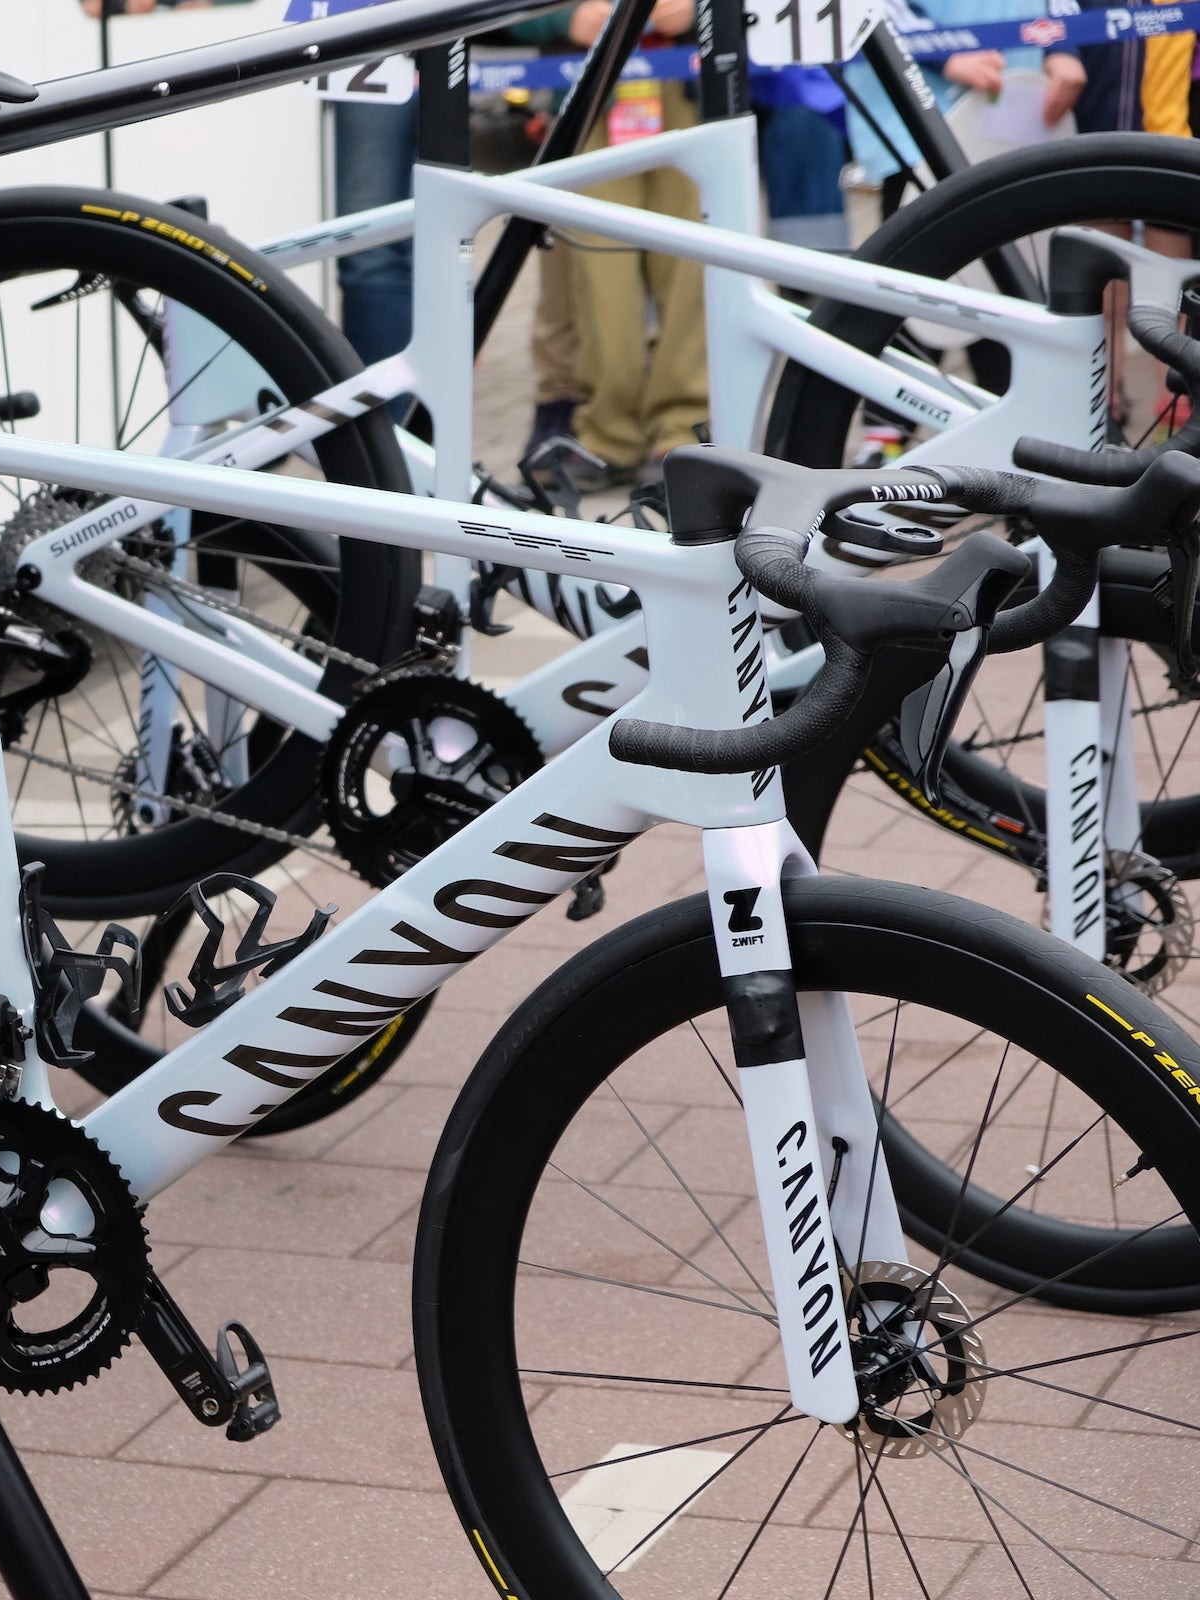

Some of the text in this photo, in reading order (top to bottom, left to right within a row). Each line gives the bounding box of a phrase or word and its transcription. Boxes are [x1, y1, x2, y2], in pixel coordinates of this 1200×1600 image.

[776, 0, 842, 62] 11
[448, 37, 465, 89] YON
[140, 218, 205, 250] ZERO
[871, 484, 943, 501] CANYON
[50, 503, 138, 558] SHIMANO
[728, 576, 776, 802] CANYN
[1070, 744, 1101, 940] CANYON
[731, 934, 765, 948] ZWIFT
[158, 812, 648, 1137] CANYON
[1131, 1031, 1200, 1106] P ZER
[776, 1120, 842, 1379] CANYON
